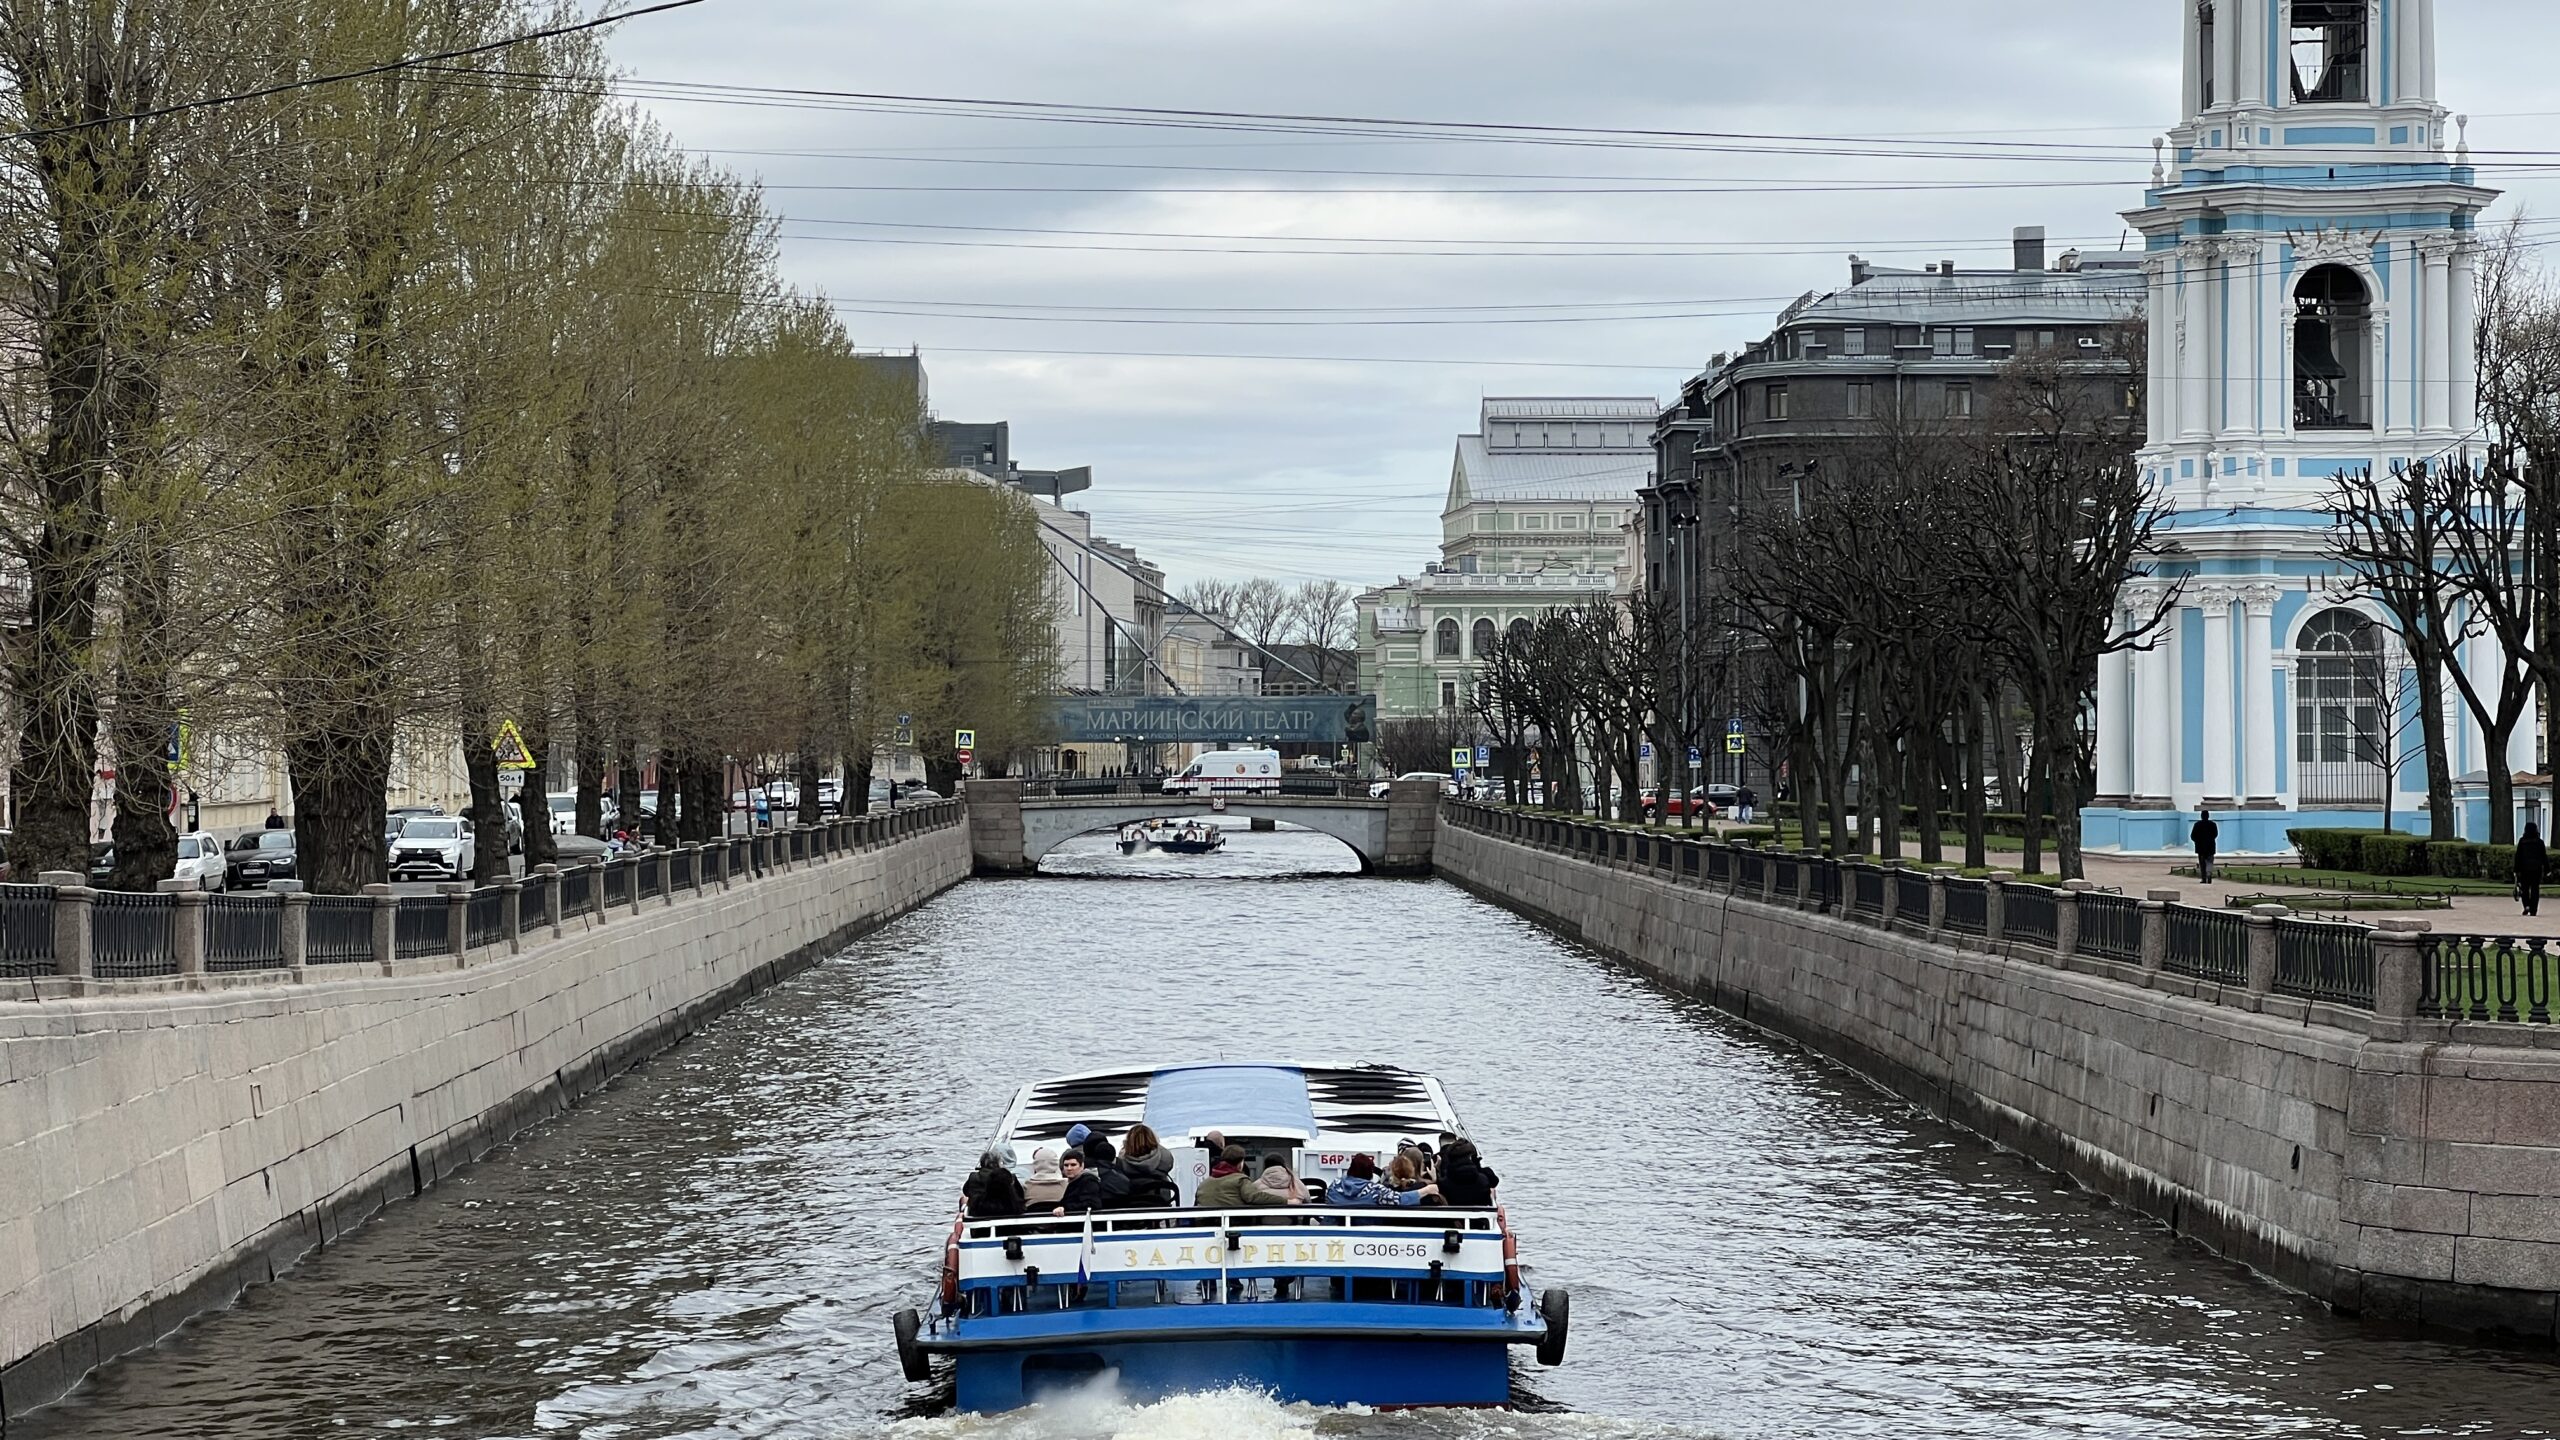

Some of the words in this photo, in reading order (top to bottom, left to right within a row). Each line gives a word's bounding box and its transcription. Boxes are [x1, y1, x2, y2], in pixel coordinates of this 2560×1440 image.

[1086, 708, 1244, 730] МАРИИНСКИЙ
[1250, 710, 1314, 730] ТЕАТР
[1321, 1154, 1345, 1165] БАР
[1124, 1239, 1346, 1268] ЗАДОРНЫЙ
